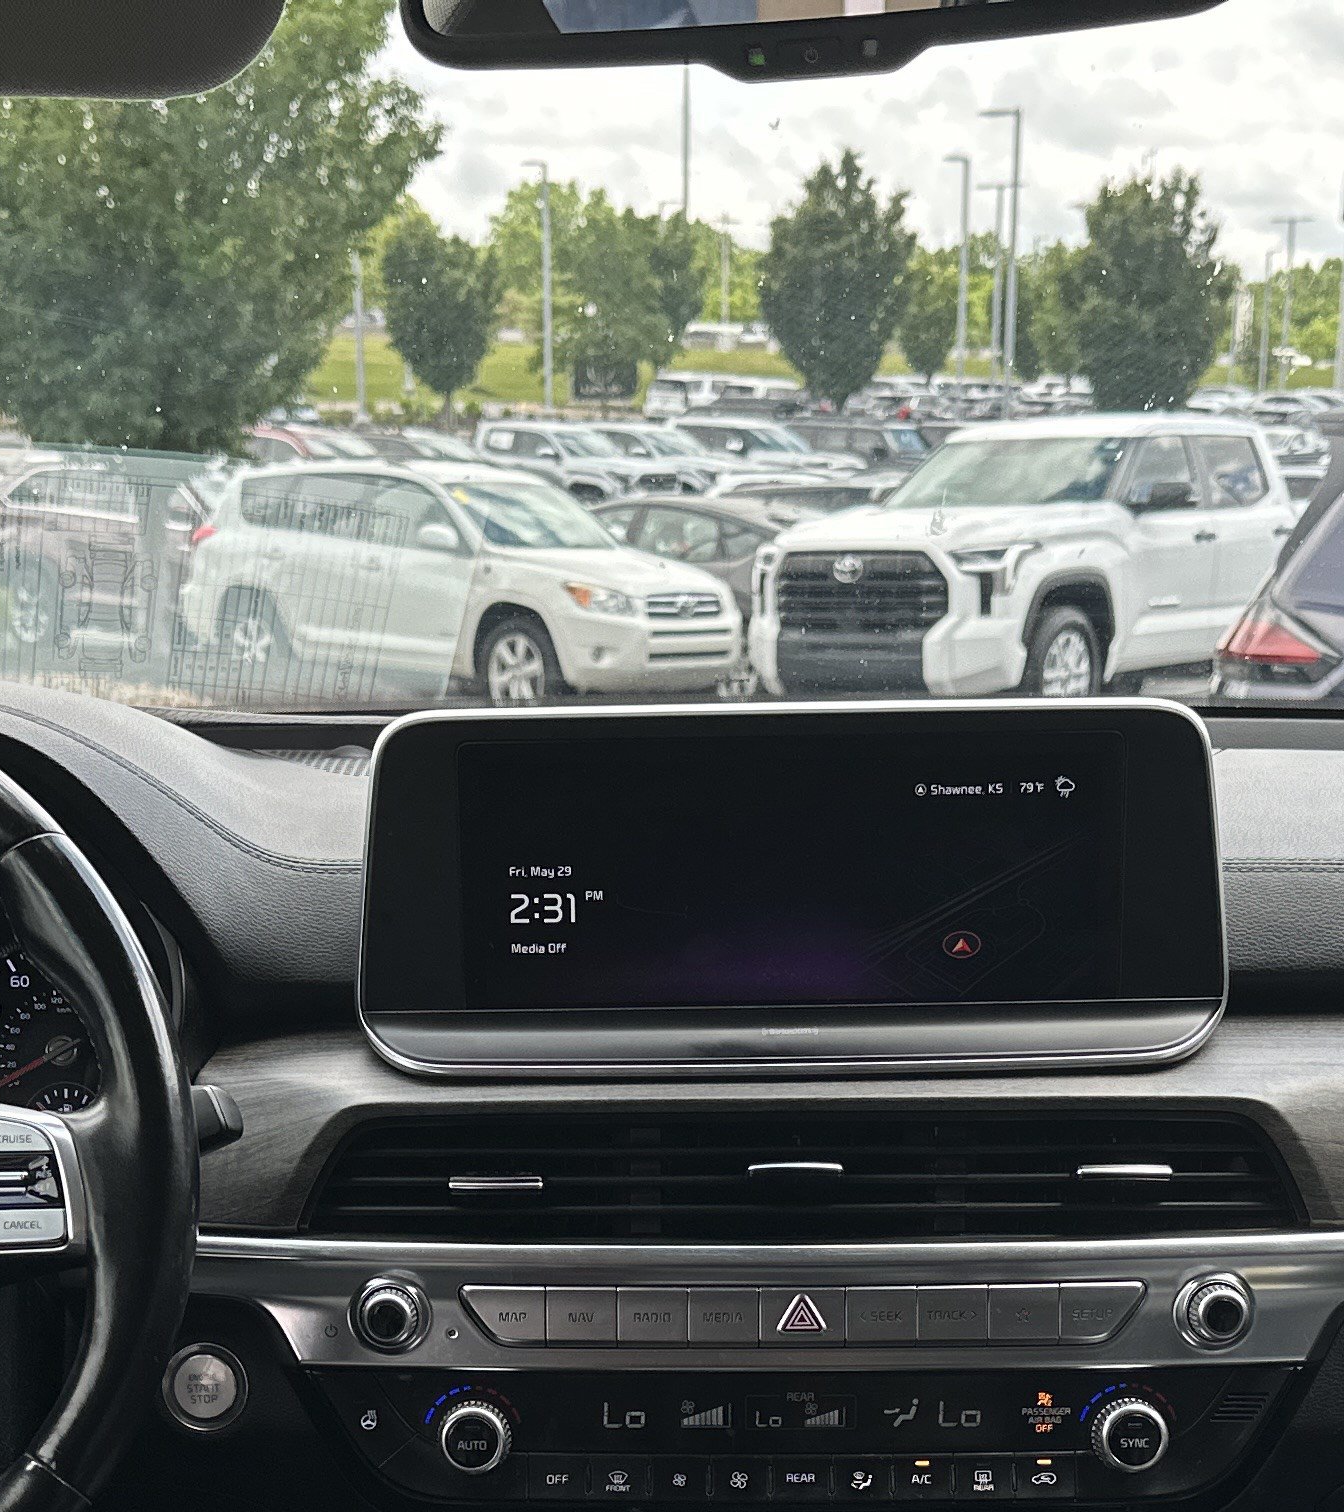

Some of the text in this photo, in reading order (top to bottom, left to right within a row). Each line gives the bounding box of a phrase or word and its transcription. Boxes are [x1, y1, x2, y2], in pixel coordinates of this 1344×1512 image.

[930, 783, 1003, 795] Shawnee, KS
[509, 866, 572, 878] Fri, May 29
[510, 890, 603, 923] 2:31 PM
[511, 943, 567, 954] Media Off
[10, 975, 30, 988] 60
[3, 1220, 43, 1231] CANCEL
[498, 1312, 527, 1323] MAP
[568, 1312, 595, 1323] NAV
[633, 1312, 671, 1323] RADIO
[702, 1312, 744, 1323] MEDIA
[870, 1310, 902, 1322] SEEK
[927, 1310, 967, 1321] TRACK
[1072, 1309, 1113, 1321] SETUP
[186, 1383, 221, 1393] START
[190, 1394, 218, 1404] STOP
[786, 1392, 814, 1401] REAR
[1021, 1407, 1071, 1415] PASSENGER
[1035, 1424, 1053, 1432] OFF
[457, 1440, 487, 1450] AUTO
[1120, 1438, 1150, 1448] SYNC
[546, 1474, 569, 1485] OFF
[786, 1473, 815, 1482] REAR
[911, 1474, 932, 1484] A/C
